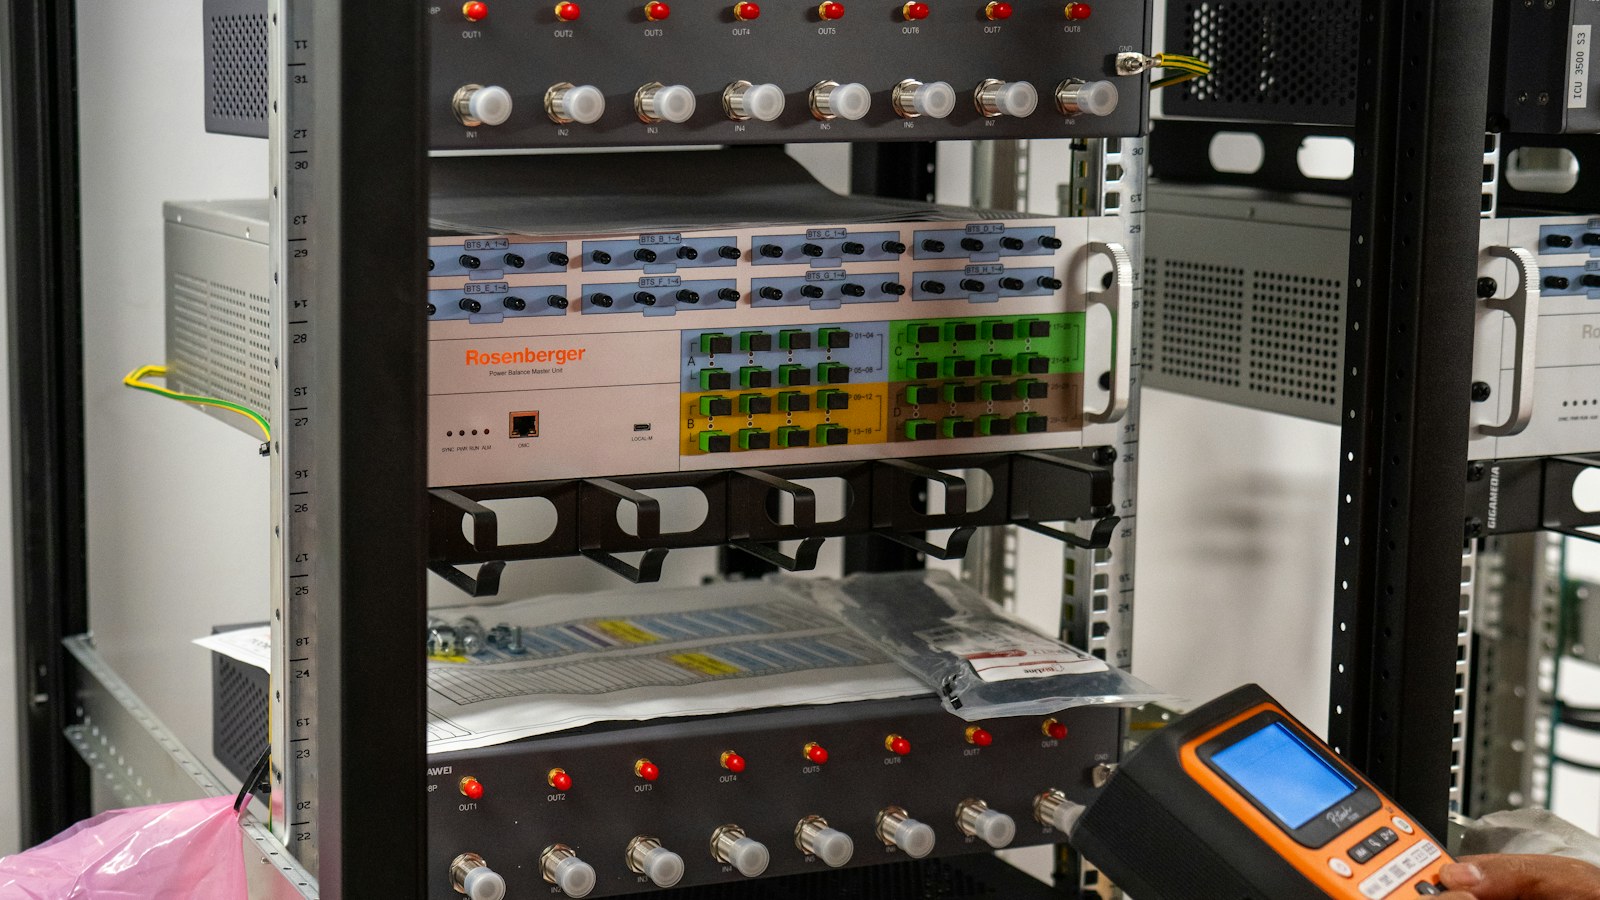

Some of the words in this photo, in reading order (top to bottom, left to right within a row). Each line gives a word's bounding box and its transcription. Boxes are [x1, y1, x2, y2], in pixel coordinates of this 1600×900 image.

[644, 29, 663, 37] OUT3
[732, 28, 750, 36] OUT4
[818, 27, 836, 35] OUT5
[902, 27, 920, 35] OUT6
[983, 26, 1001, 34] OUT7
[1064, 25, 1081, 33] OUT8
[461, 31, 481, 39] OUT1
[554, 30, 573, 38] OUT2
[1577, 32, 1586, 45] S3
[294, 40, 308, 49] 11
[1575, 51, 1584, 75] 3500
[294, 75, 308, 83] 31
[1573, 81, 1583, 99] ICU
[820, 123, 831, 131] IN5
[903, 121, 914, 129] IN6
[985, 119, 996, 127] IN7
[557, 129, 569, 137] IN2
[647, 127, 658, 135] IN3
[734, 125, 745, 133] IN4
[293, 129, 308, 139] 12
[1132, 148, 1143, 156] 30
[294, 161, 308, 170] 30
[1130, 193, 1142, 202] 13
[293, 215, 308, 225] 13
[1129, 225, 1141, 233] 29
[641, 235, 680, 244] BTS_B_1~4
[466, 241, 507, 250] BTS_A_1~4
[294, 249, 308, 258] 29
[641, 278, 679, 287] BTS_F_1~4
[466, 285, 507, 294] BTS_E_1~4
[1582, 324, 1600, 339] Ro
[293, 334, 307, 344] 28
[895, 346, 902, 356] C
[466, 347, 586, 365] Rosenberger
[687, 356, 696, 366] A
[293, 386, 308, 396] 15
[294, 417, 309, 427] 27
[687, 418, 695, 429] B
[294, 469, 309, 479] 16
[1487, 466, 1500, 529] GIGAMEDIA
[294, 504, 309, 513] 26
[295, 553, 309, 563] 17
[295, 586, 309, 595] 25
[296, 637, 310, 646] 18
[296, 669, 310, 678] 24
[296, 717, 310, 727] 19
[296, 749, 311, 759] 23
[427, 766, 452, 776] AWEI
[802, 766, 820, 774] OUT5
[719, 775, 737, 783] OUT4
[634, 784, 652, 793] OUT3
[547, 793, 566, 802] OUT2
[297, 801, 311, 810] 20
[458, 803, 477, 811] OUT1
[297, 832, 311, 841] 22
